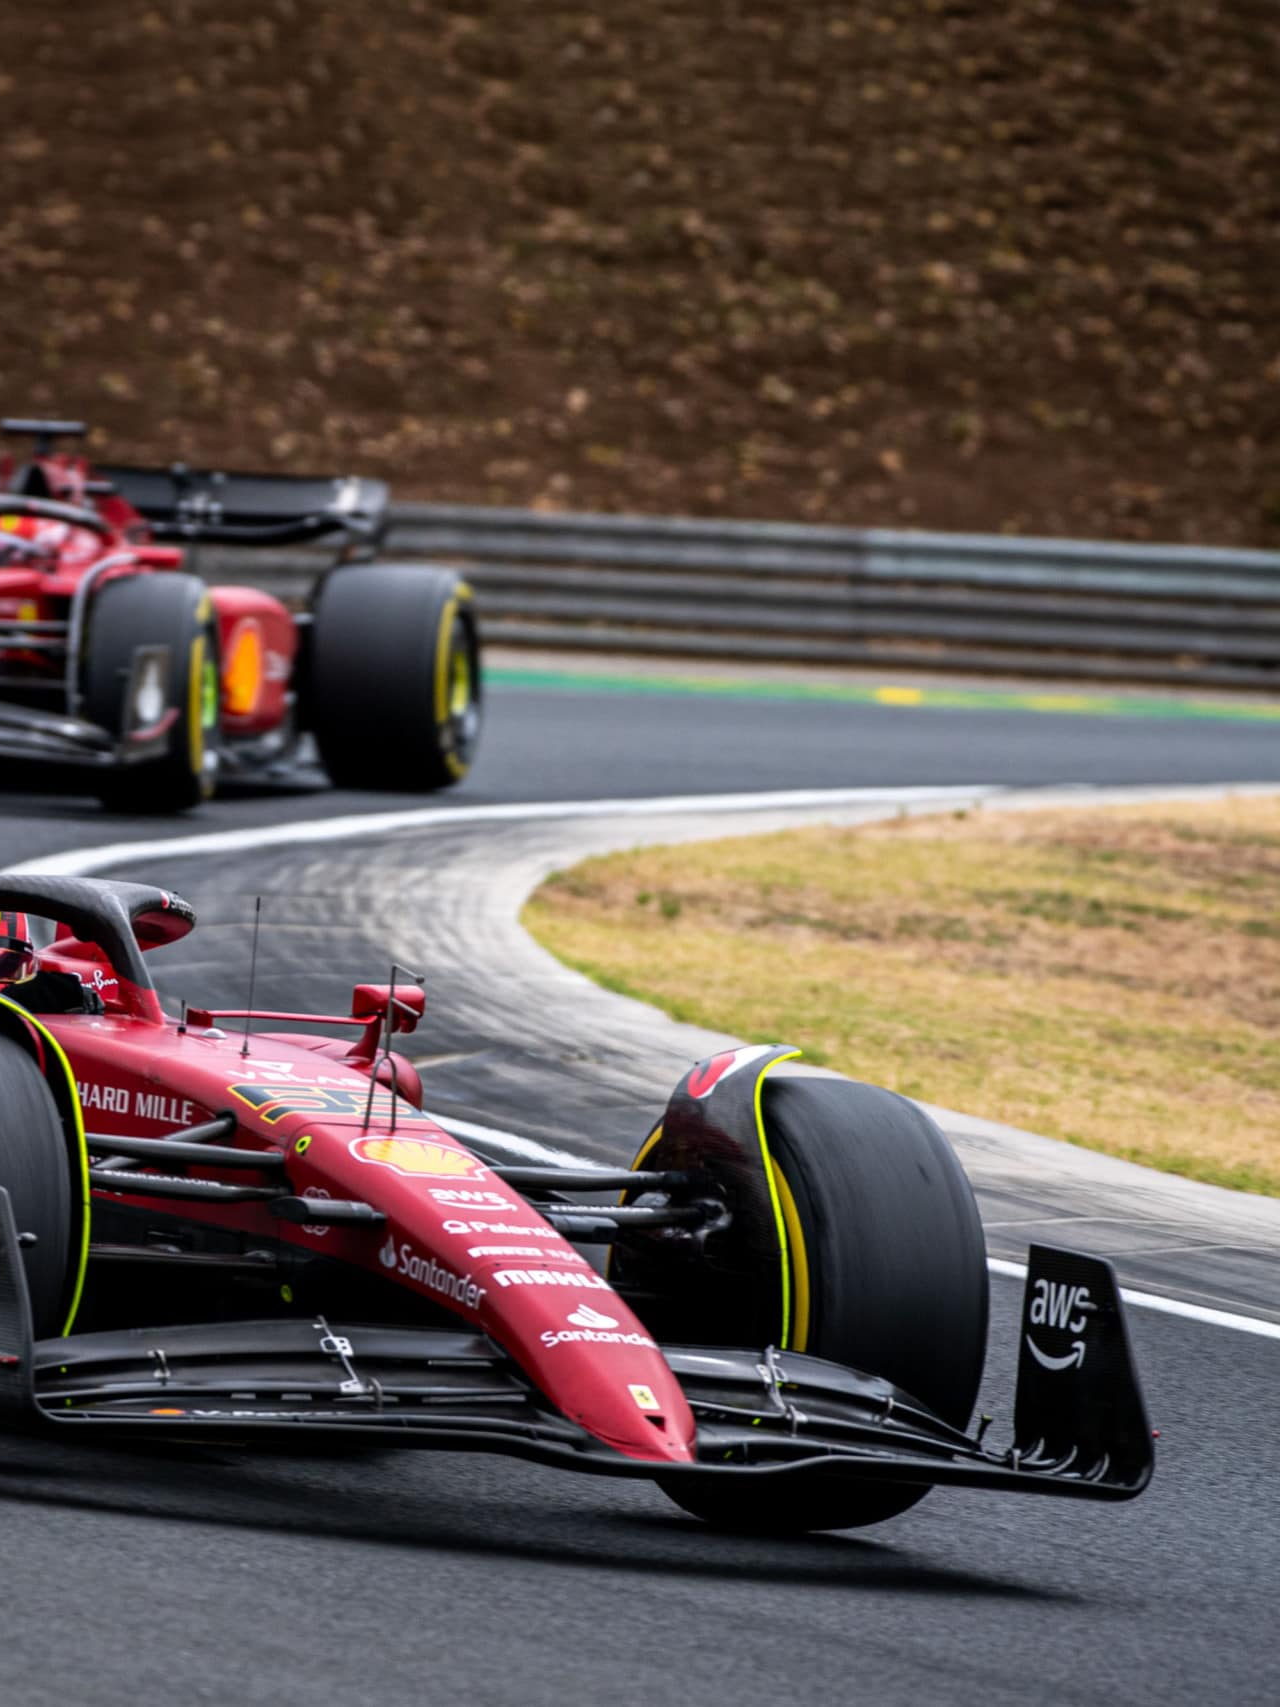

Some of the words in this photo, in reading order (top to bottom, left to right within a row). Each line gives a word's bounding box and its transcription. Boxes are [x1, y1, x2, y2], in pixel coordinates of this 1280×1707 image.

[77, 1081, 130, 1114] HARD
[135, 1092, 194, 1125] MILLE
[428, 1188, 507, 1204] aws
[470, 1221, 562, 1239] Palanti
[398, 1243, 488, 1310] Santander
[1029, 1277, 1098, 1334] aws
